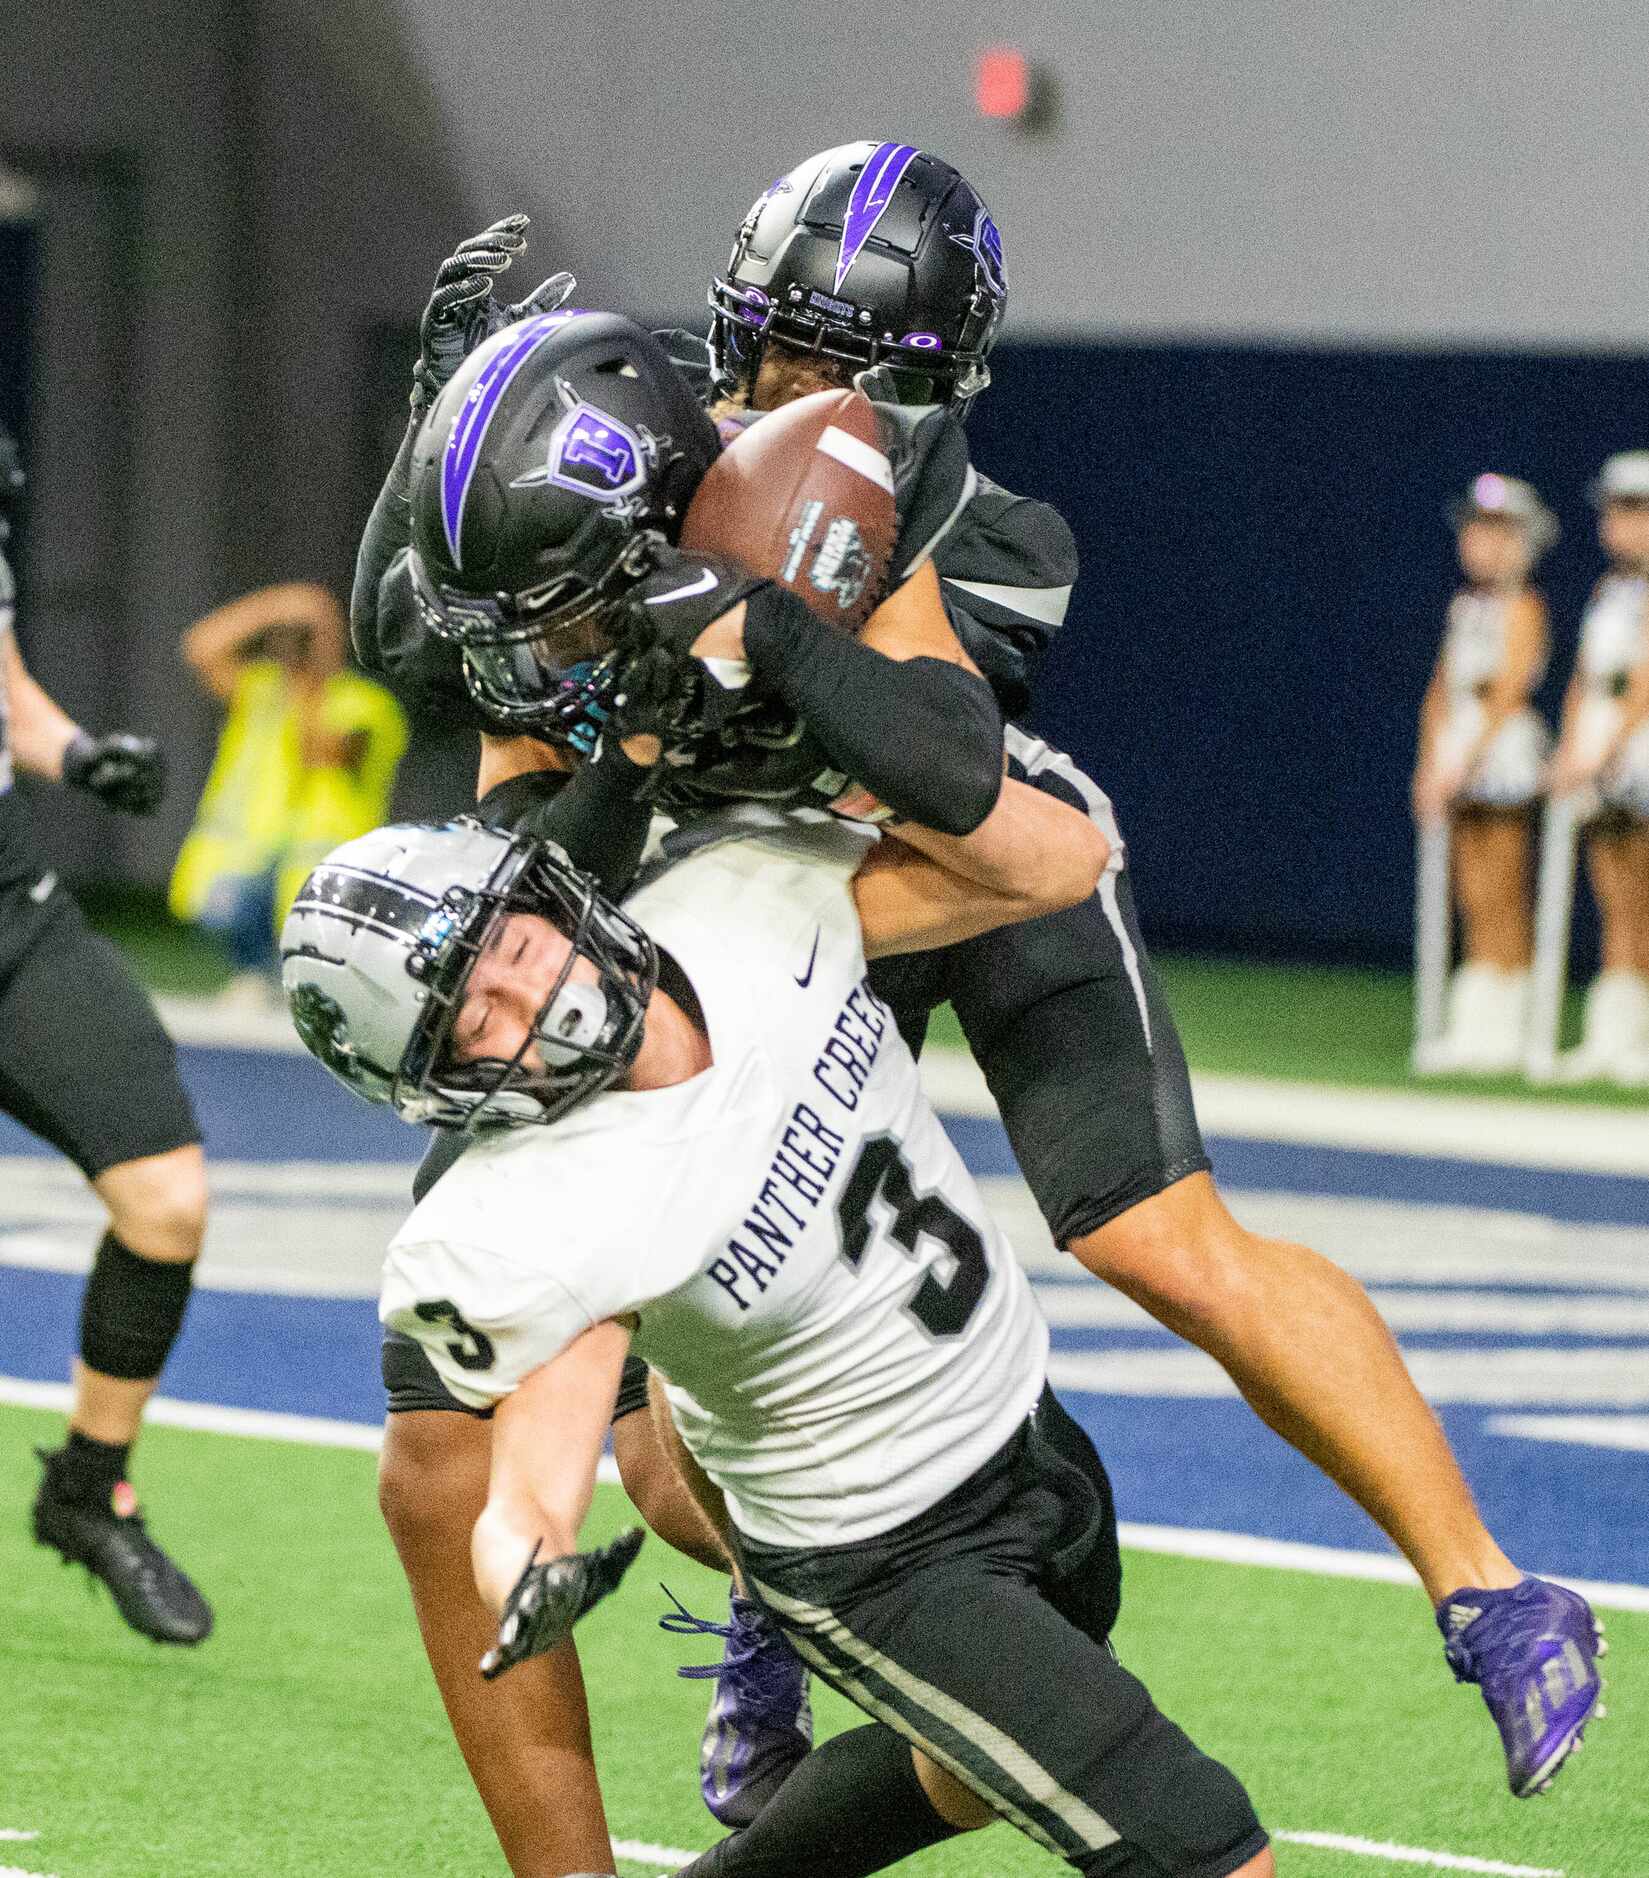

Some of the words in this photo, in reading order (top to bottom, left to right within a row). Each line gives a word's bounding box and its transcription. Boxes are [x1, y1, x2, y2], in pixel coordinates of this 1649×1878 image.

[706, 1102, 845, 1311] PANTHER
[834, 1128, 994, 1344] 3
[413, 1299, 496, 1371] 3
